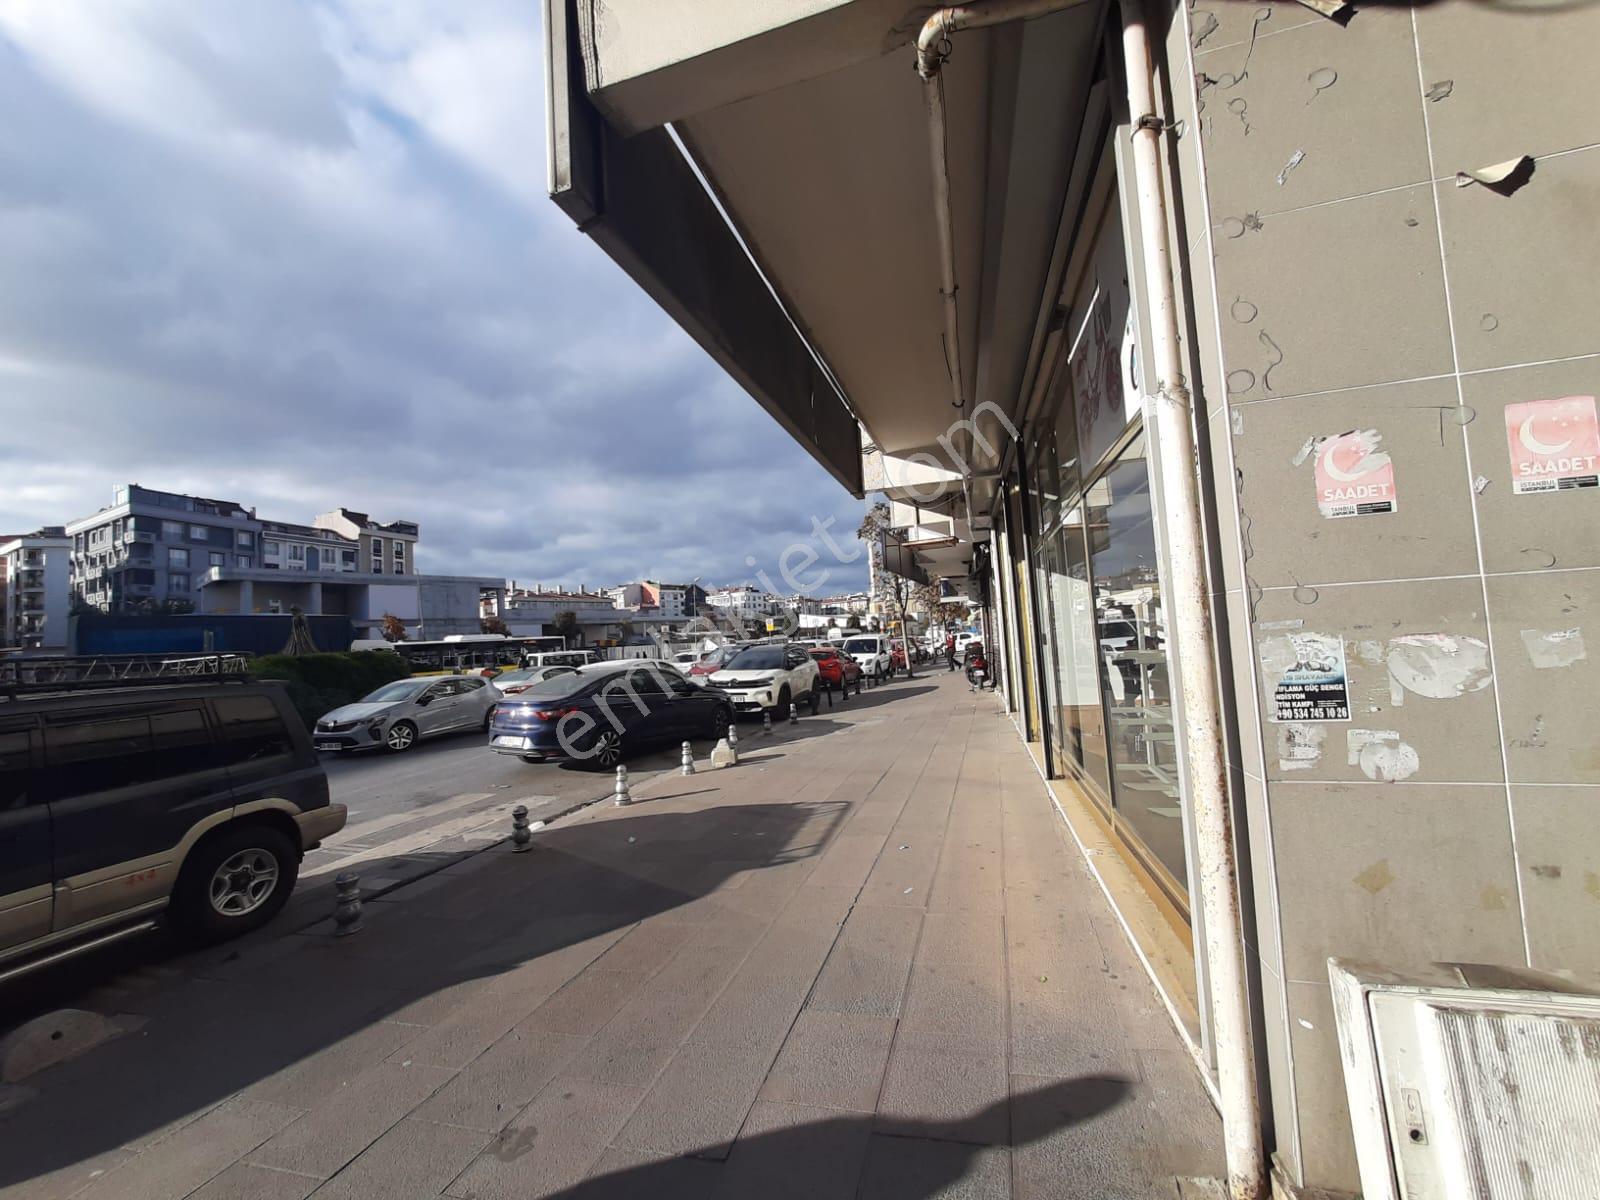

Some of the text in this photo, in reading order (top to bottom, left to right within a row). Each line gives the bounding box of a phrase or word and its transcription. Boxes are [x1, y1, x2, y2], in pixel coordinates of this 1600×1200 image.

[1519, 455, 1597, 476] SAADET
[1323, 483, 1390, 502] SAADET
[1293, 708, 1309, 719] 534
[1309, 707, 1325, 719] 745
[1326, 707, 1336, 718] 10
[1336, 706, 1347, 718] 26
